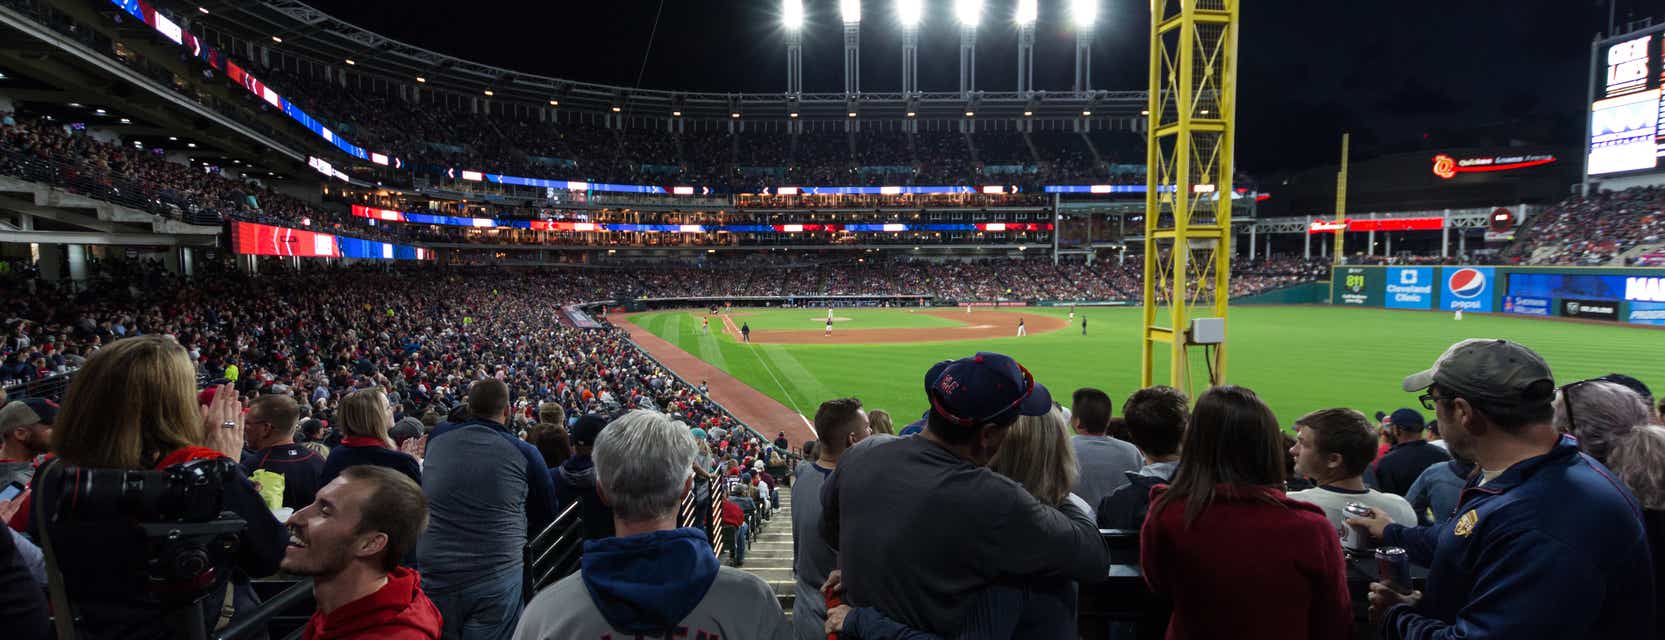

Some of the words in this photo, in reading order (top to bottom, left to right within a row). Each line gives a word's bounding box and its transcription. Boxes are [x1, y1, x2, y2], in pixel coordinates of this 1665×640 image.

[1346, 275, 1364, 288] 811
[1386, 285, 1432, 293] Cleveland
[1395, 293, 1421, 302] Clinic
[1450, 301, 1481, 309] pepsi
